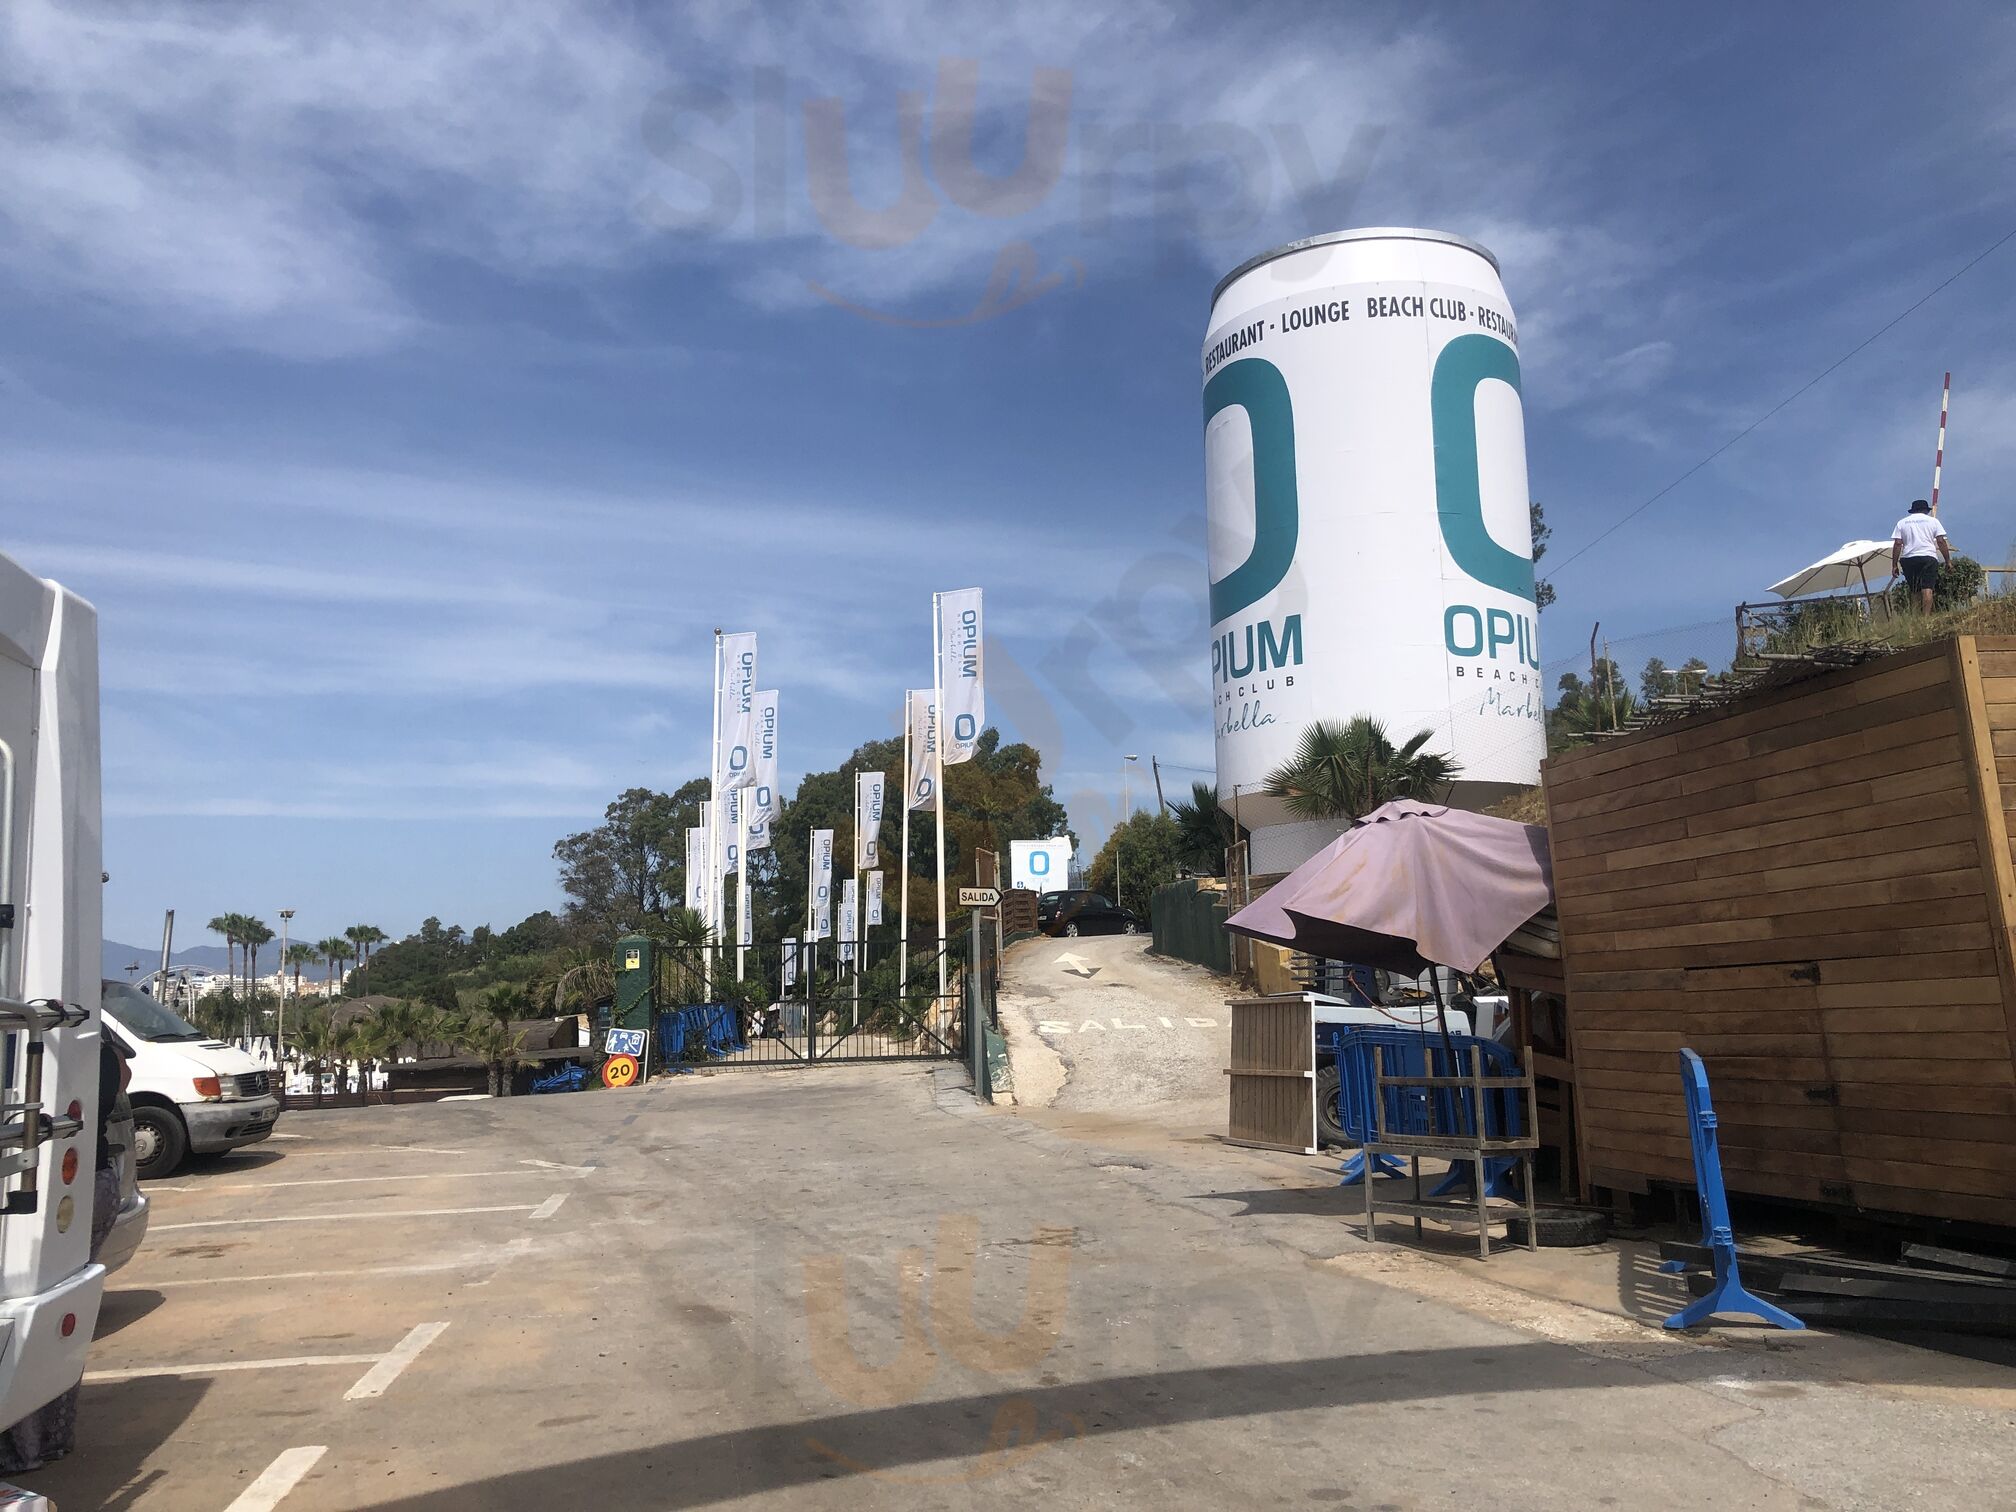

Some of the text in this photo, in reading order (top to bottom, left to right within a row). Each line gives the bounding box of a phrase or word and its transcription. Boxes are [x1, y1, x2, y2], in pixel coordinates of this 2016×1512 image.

[1367, 296, 1424, 318] BEACH
[1430, 298, 1467, 322] CLUB
[1205, 300, 1350, 376] RESTAURANT LOUNGE
[962, 610, 976, 677] OPIUM
[1211, 613, 1303, 690] PIUM
[1443, 604, 1540, 671] OPIU
[741, 652, 753, 713] OPIUM
[762, 706, 775, 759] OPIUM
[1214, 699, 1277, 740] rbella
[872, 783, 881, 822] OPIUM
[822, 839, 831, 871] OPIUM
[961, 891, 996, 903] SALIDA
[1038, 1017, 1232, 1034] SALID
[610, 1064, 631, 1080] 20
